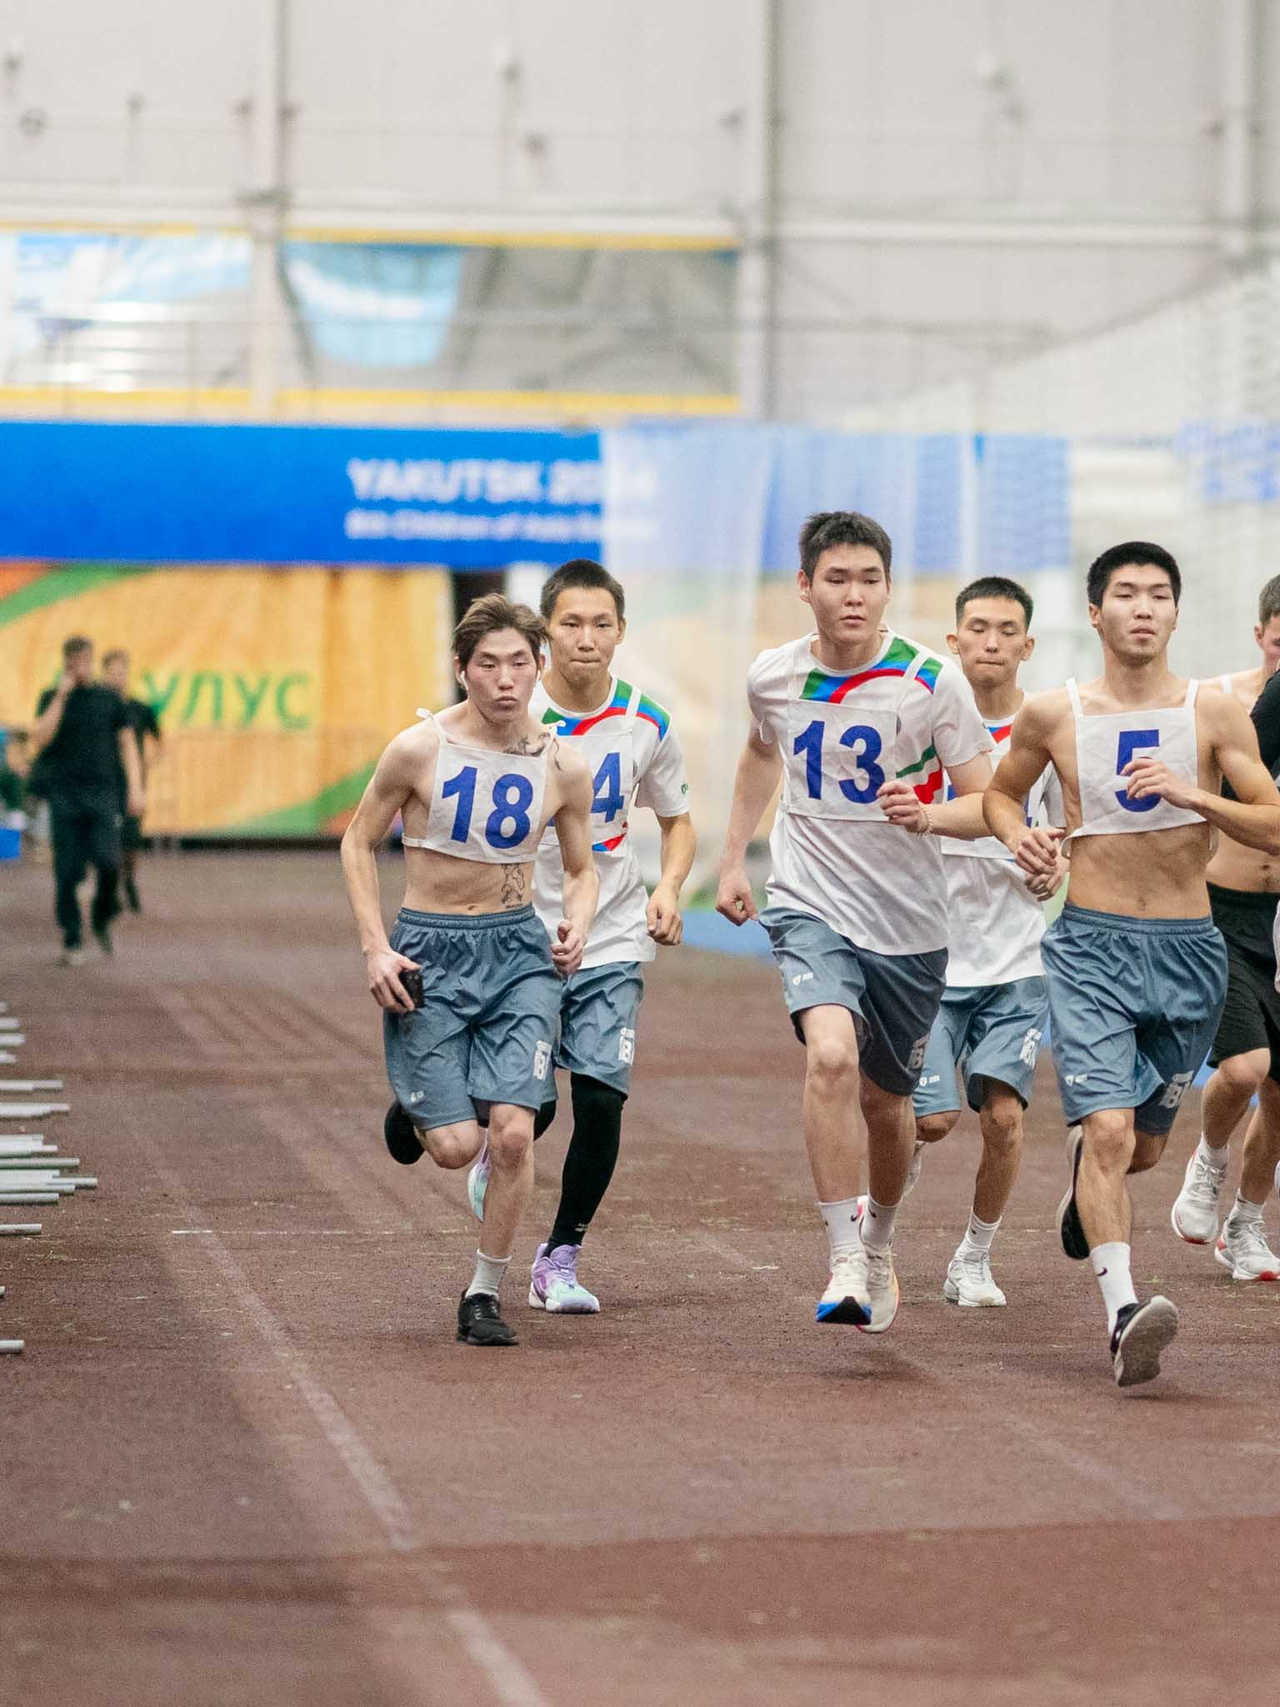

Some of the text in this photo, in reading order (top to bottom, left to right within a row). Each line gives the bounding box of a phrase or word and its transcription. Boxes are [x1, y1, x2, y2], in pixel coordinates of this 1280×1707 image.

[793, 719, 886, 804] 13
[1114, 729, 1161, 812] 5
[441, 765, 534, 849] 18
